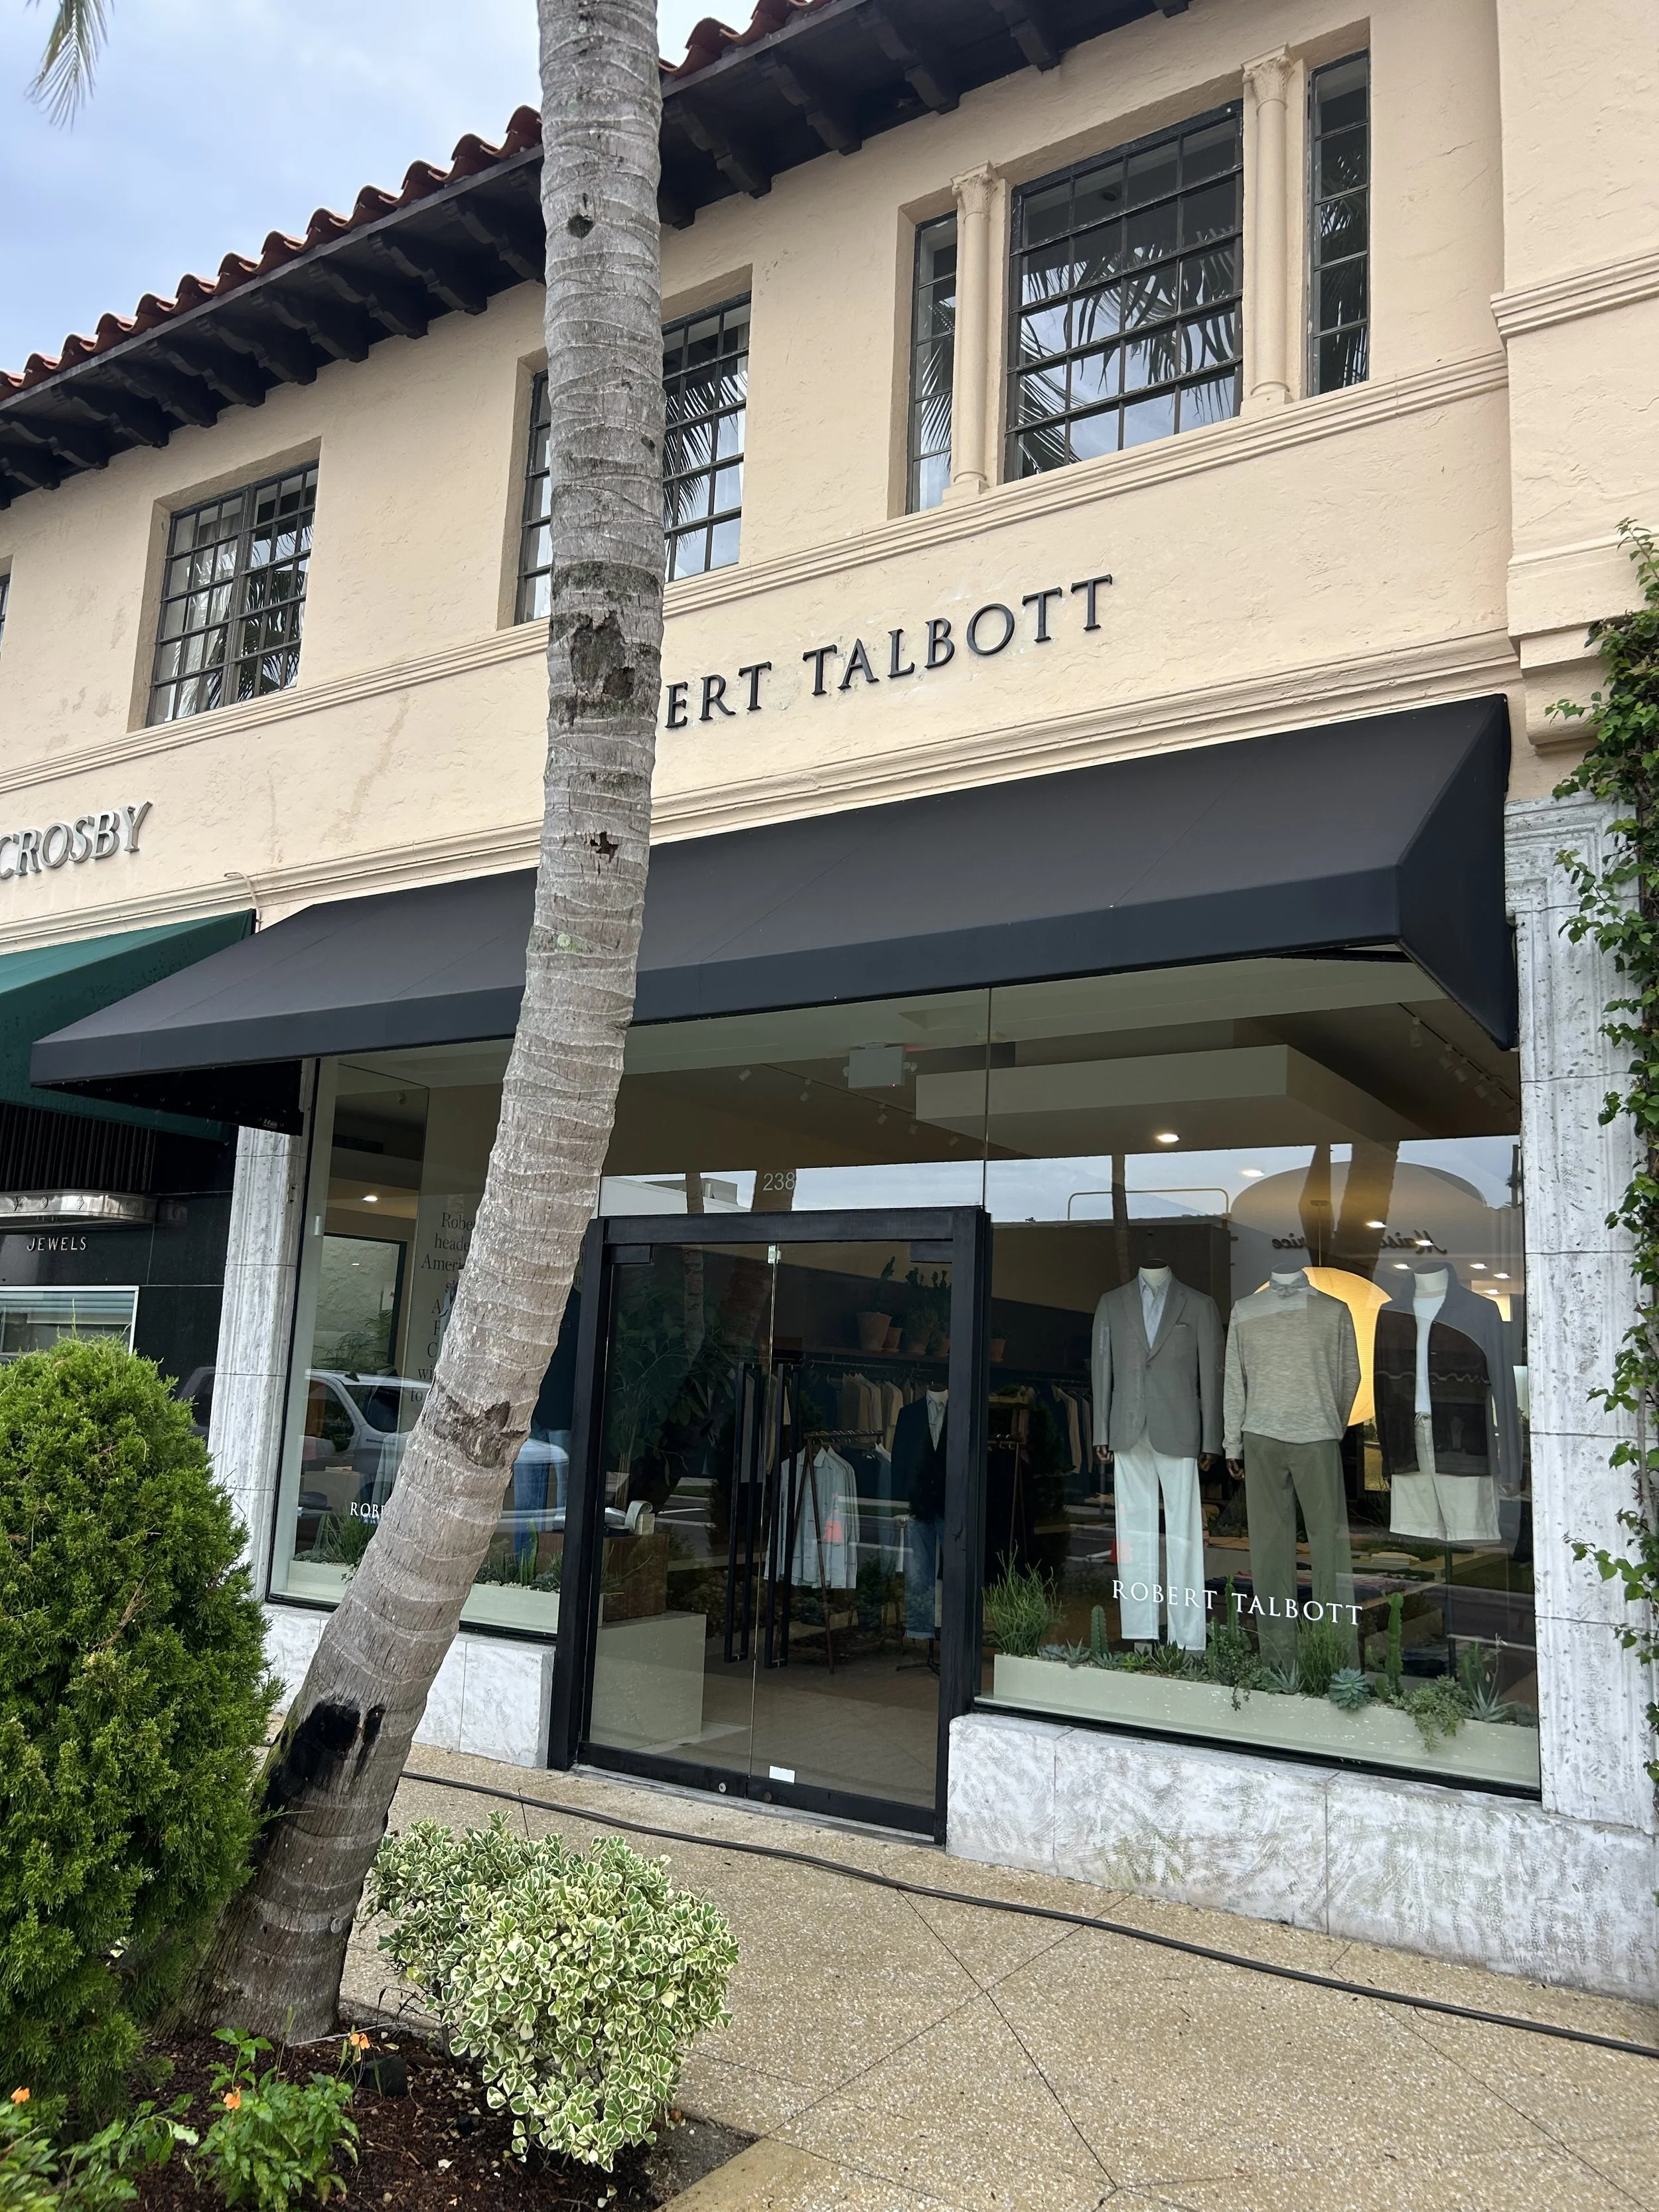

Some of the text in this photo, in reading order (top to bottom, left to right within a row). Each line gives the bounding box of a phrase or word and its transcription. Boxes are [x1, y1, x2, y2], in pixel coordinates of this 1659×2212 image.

[665, 574, 1113, 729] ERT TALBOTT
[762, 1171, 796, 1191] 238
[441, 1212, 475, 1231] Robe
[27, 1236, 87, 1252] JEWELS
[434, 1232, 470, 1252] heade
[421, 1253, 464, 1271] Ameri
[417, 1364, 433, 1380] wi
[1112, 1579, 1363, 1626] ROBERT TALBOTT
